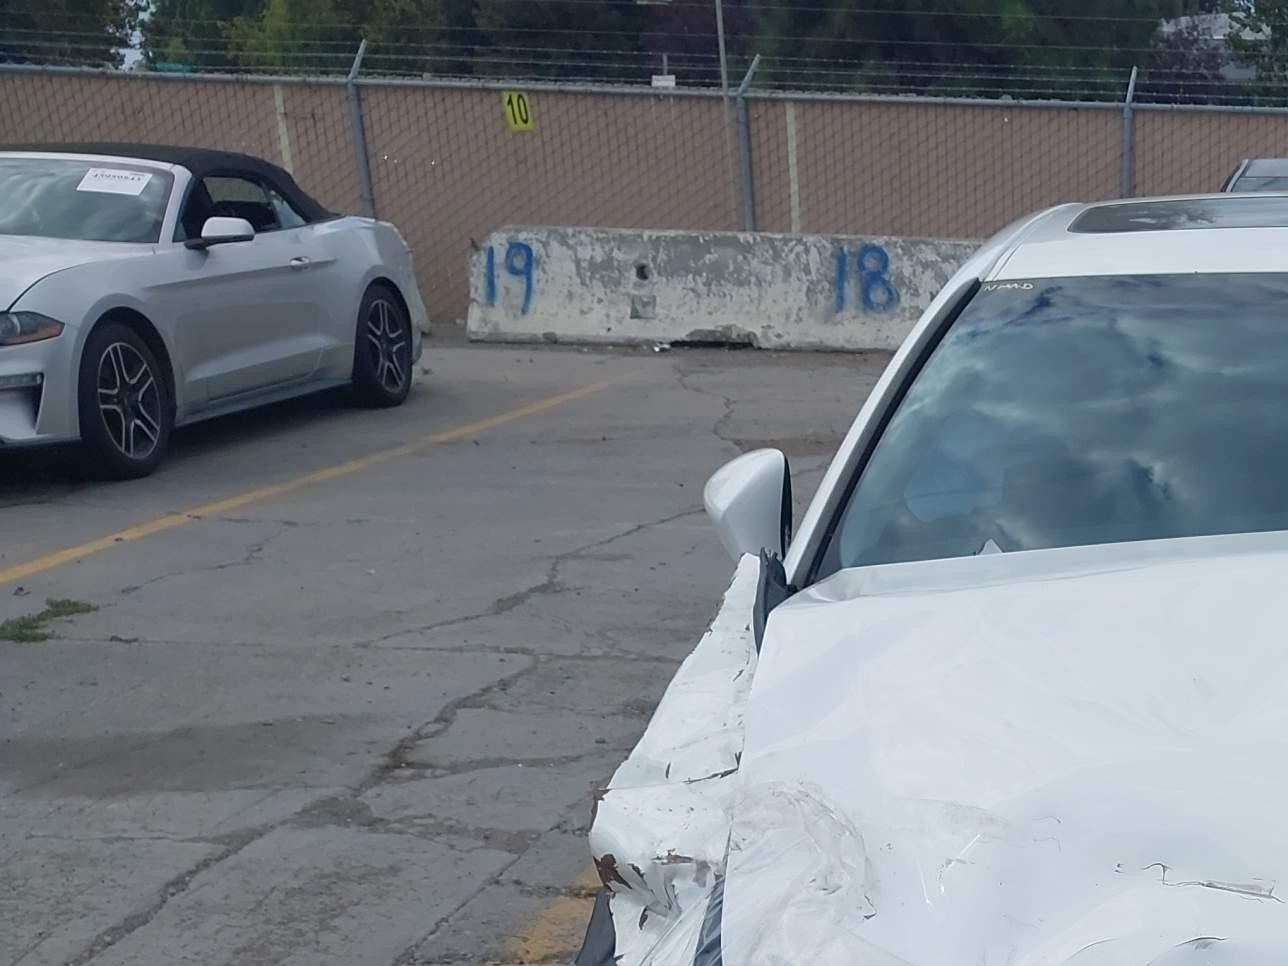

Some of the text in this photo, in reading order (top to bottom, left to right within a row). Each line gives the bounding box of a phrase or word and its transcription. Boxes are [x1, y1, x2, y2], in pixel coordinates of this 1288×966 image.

[507, 94, 528, 124] 10
[485, 241, 533, 315] 19
[835, 244, 897, 312] 18
